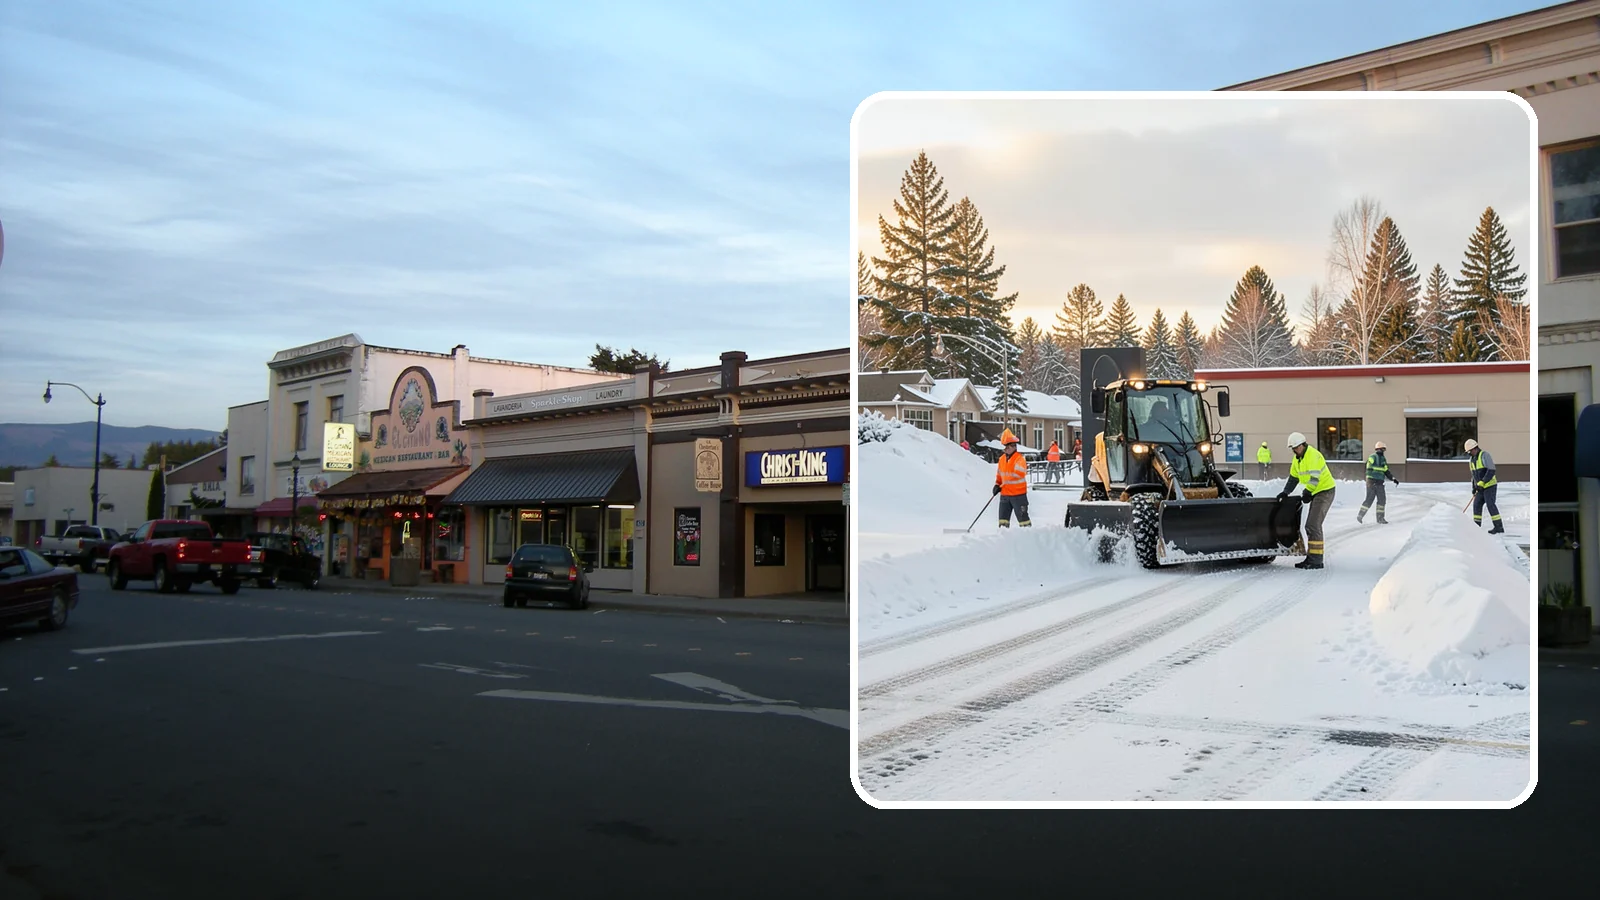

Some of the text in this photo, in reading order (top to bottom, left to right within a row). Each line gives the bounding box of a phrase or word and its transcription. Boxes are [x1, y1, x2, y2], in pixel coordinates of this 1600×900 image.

[595, 389, 623, 400] LAUNDRY
[531, 394, 582, 409] Sparkle Shop
[493, 402, 523, 413] LAVANDERIA
[397, 452, 433, 462] RESTAURANT
[438, 451, 450, 459] BAR
[799, 450, 828, 476] KING
